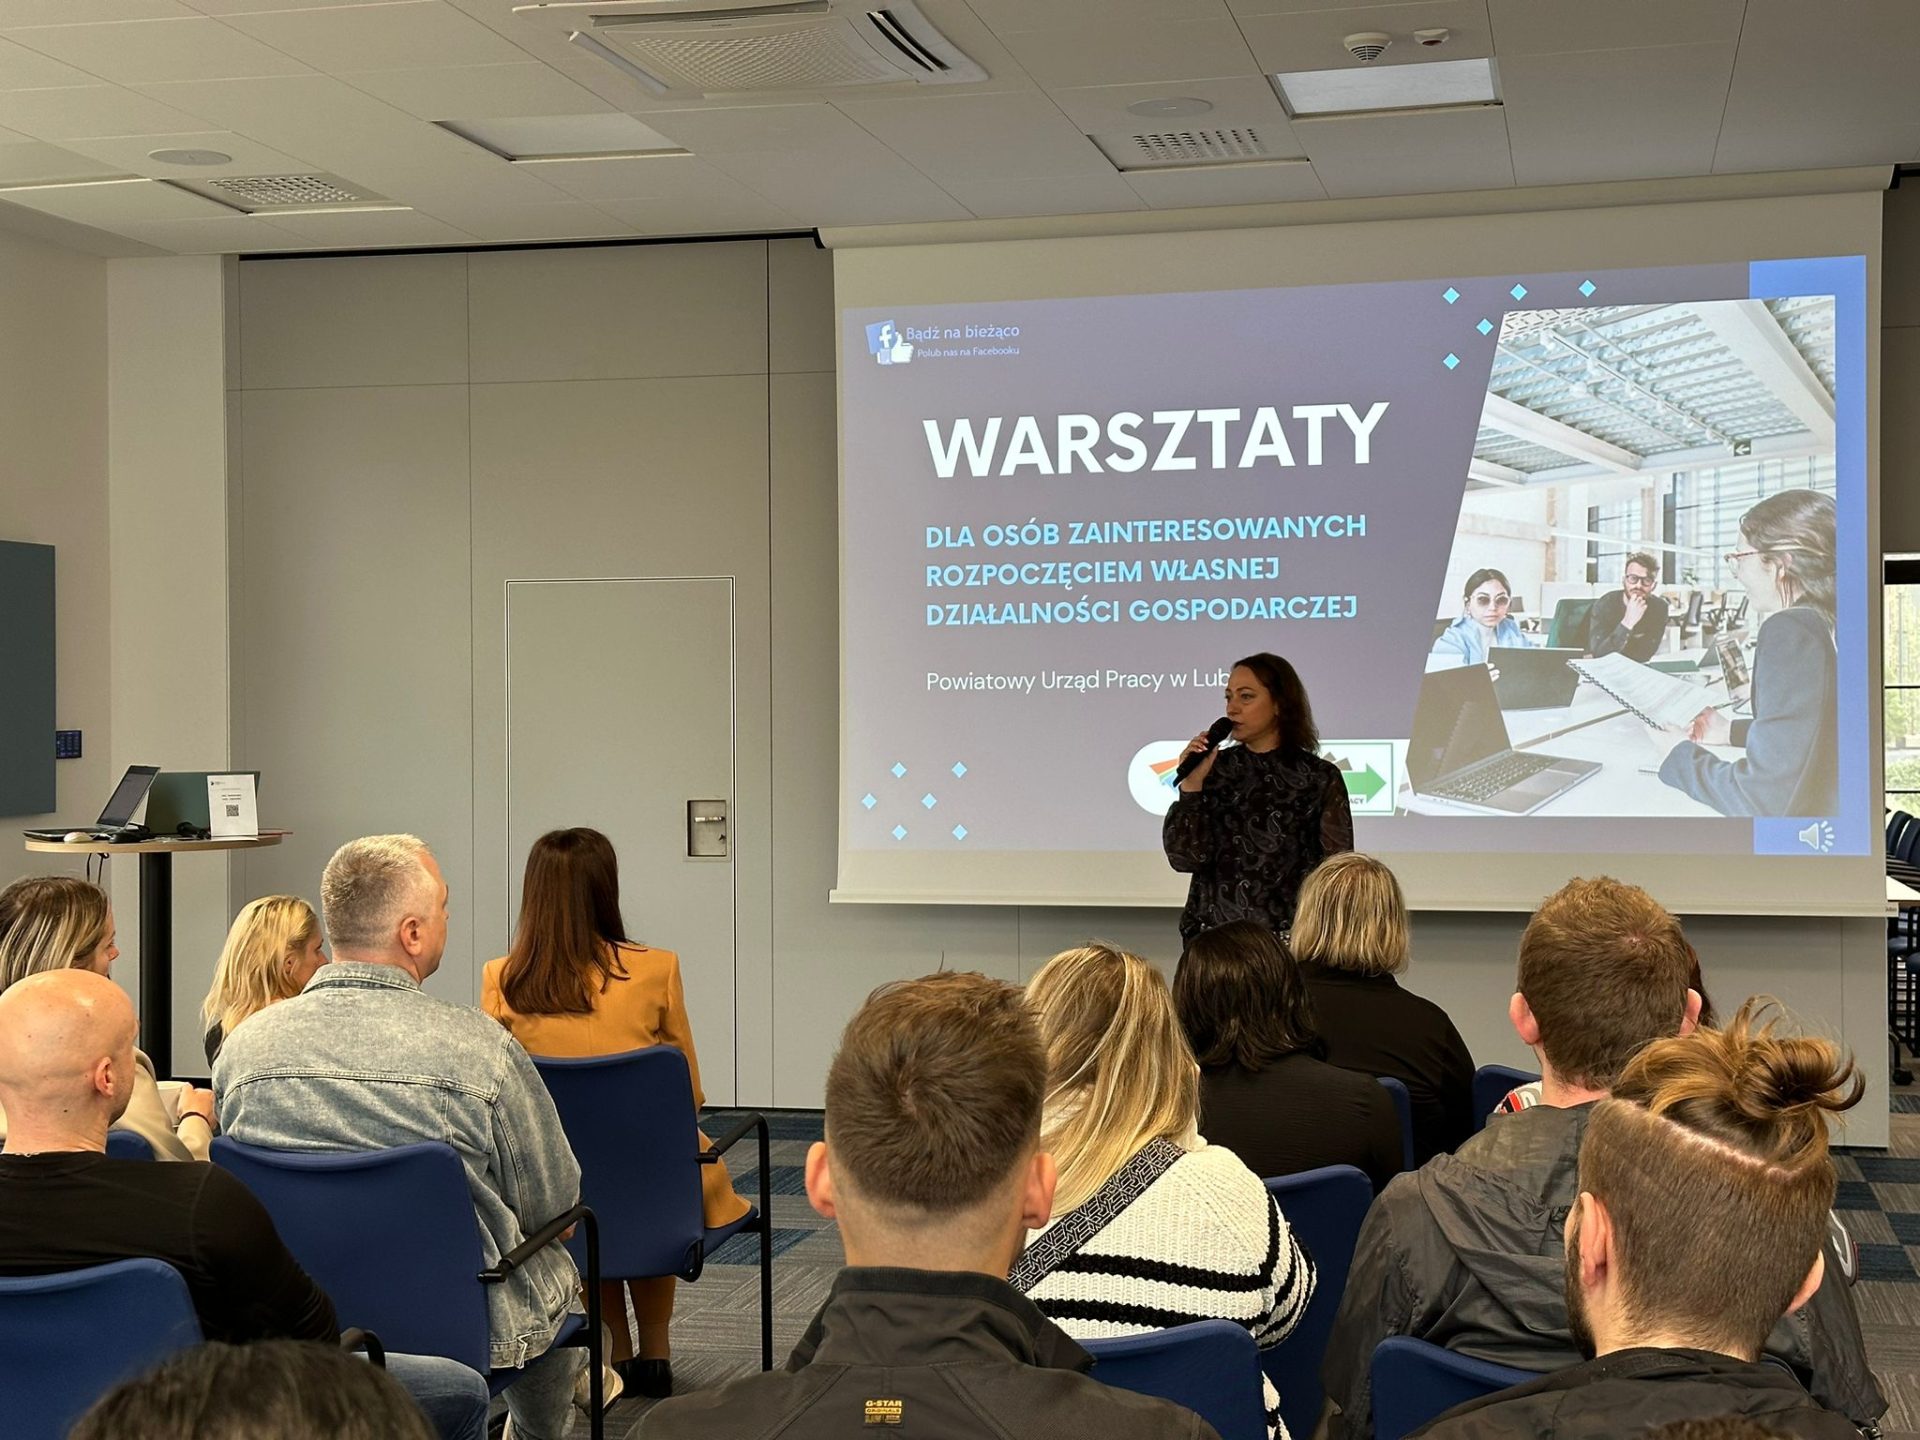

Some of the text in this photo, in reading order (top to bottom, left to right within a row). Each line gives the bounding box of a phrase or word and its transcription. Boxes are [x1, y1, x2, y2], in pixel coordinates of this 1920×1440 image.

[907, 324, 1020, 342] Bądź na bieżąco
[917, 345, 1020, 358] Polub nas na Facebooku
[922, 402, 1389, 479] WARSZTATY
[926, 514, 1366, 548] DLA OSÓB ZAINTERESOWANYCH
[926, 557, 1279, 590] ROZPOCZĘCIEM WŁASNEJ
[926, 595, 1357, 626] DZIAŁALNOŚCI GOSPODARCZEJ
[927, 668, 1230, 694] Powiatowy Urząd Pracy w Lub
